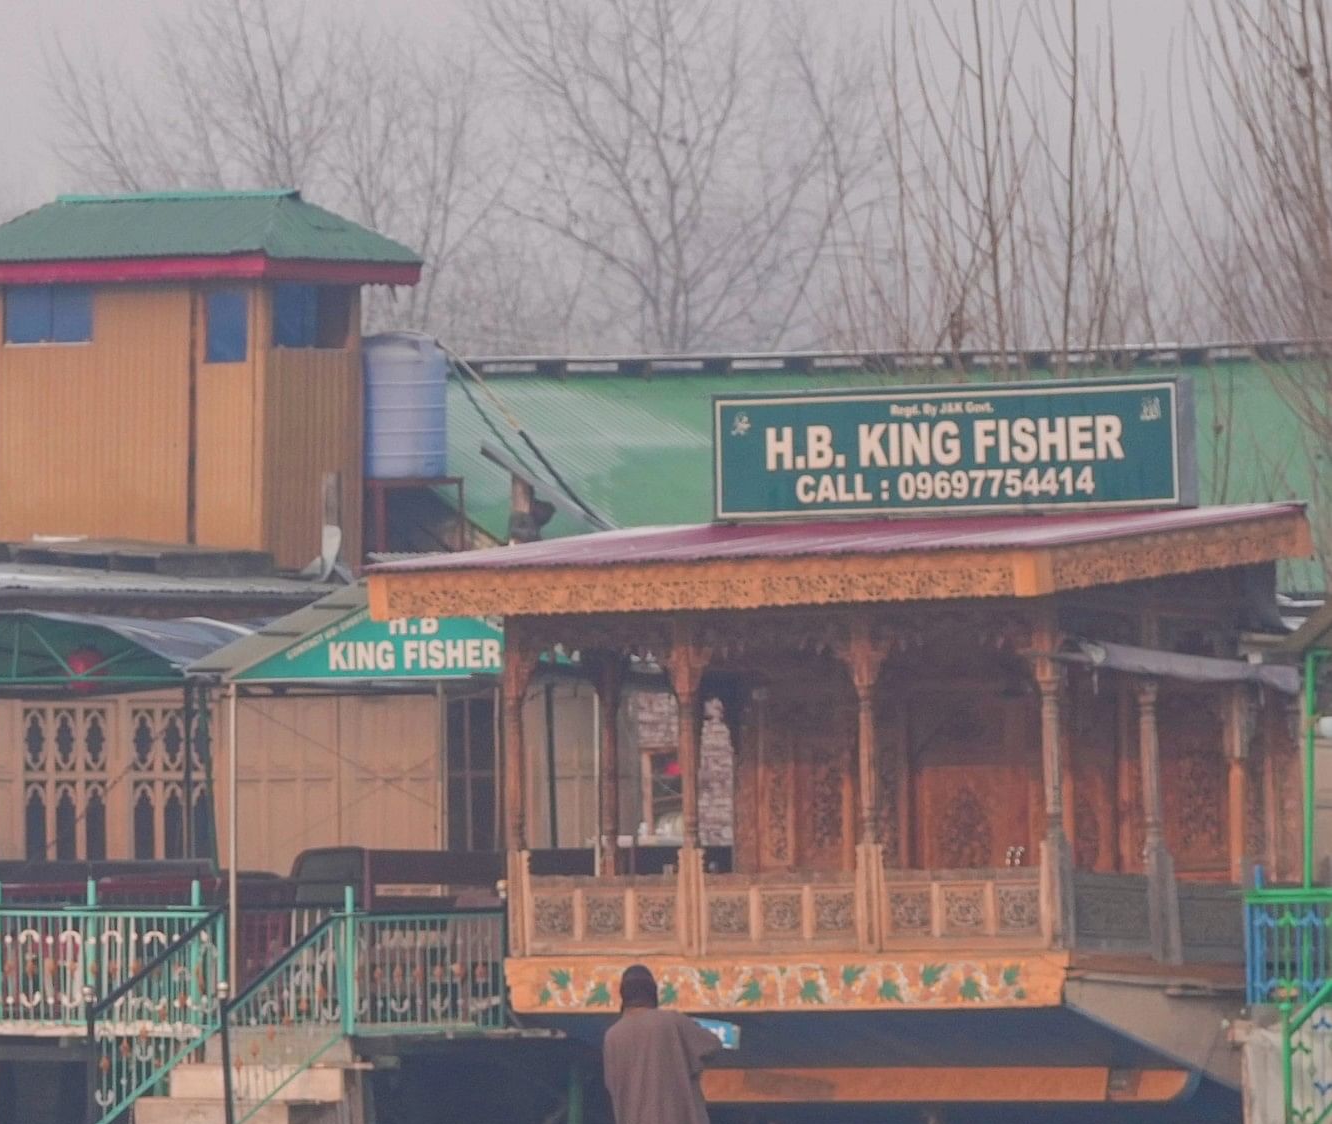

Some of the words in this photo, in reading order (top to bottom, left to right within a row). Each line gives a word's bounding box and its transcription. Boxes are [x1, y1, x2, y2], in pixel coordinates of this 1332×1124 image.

[765, 425, 847, 471] H.B.
[859, 421, 961, 468] KING
[974, 413, 1125, 464] FISHER
[795, 474, 872, 504] CALL
[898, 466, 1095, 502] 09697754414
[328, 641, 395, 671] KING
[403, 639, 502, 670] FISHER
